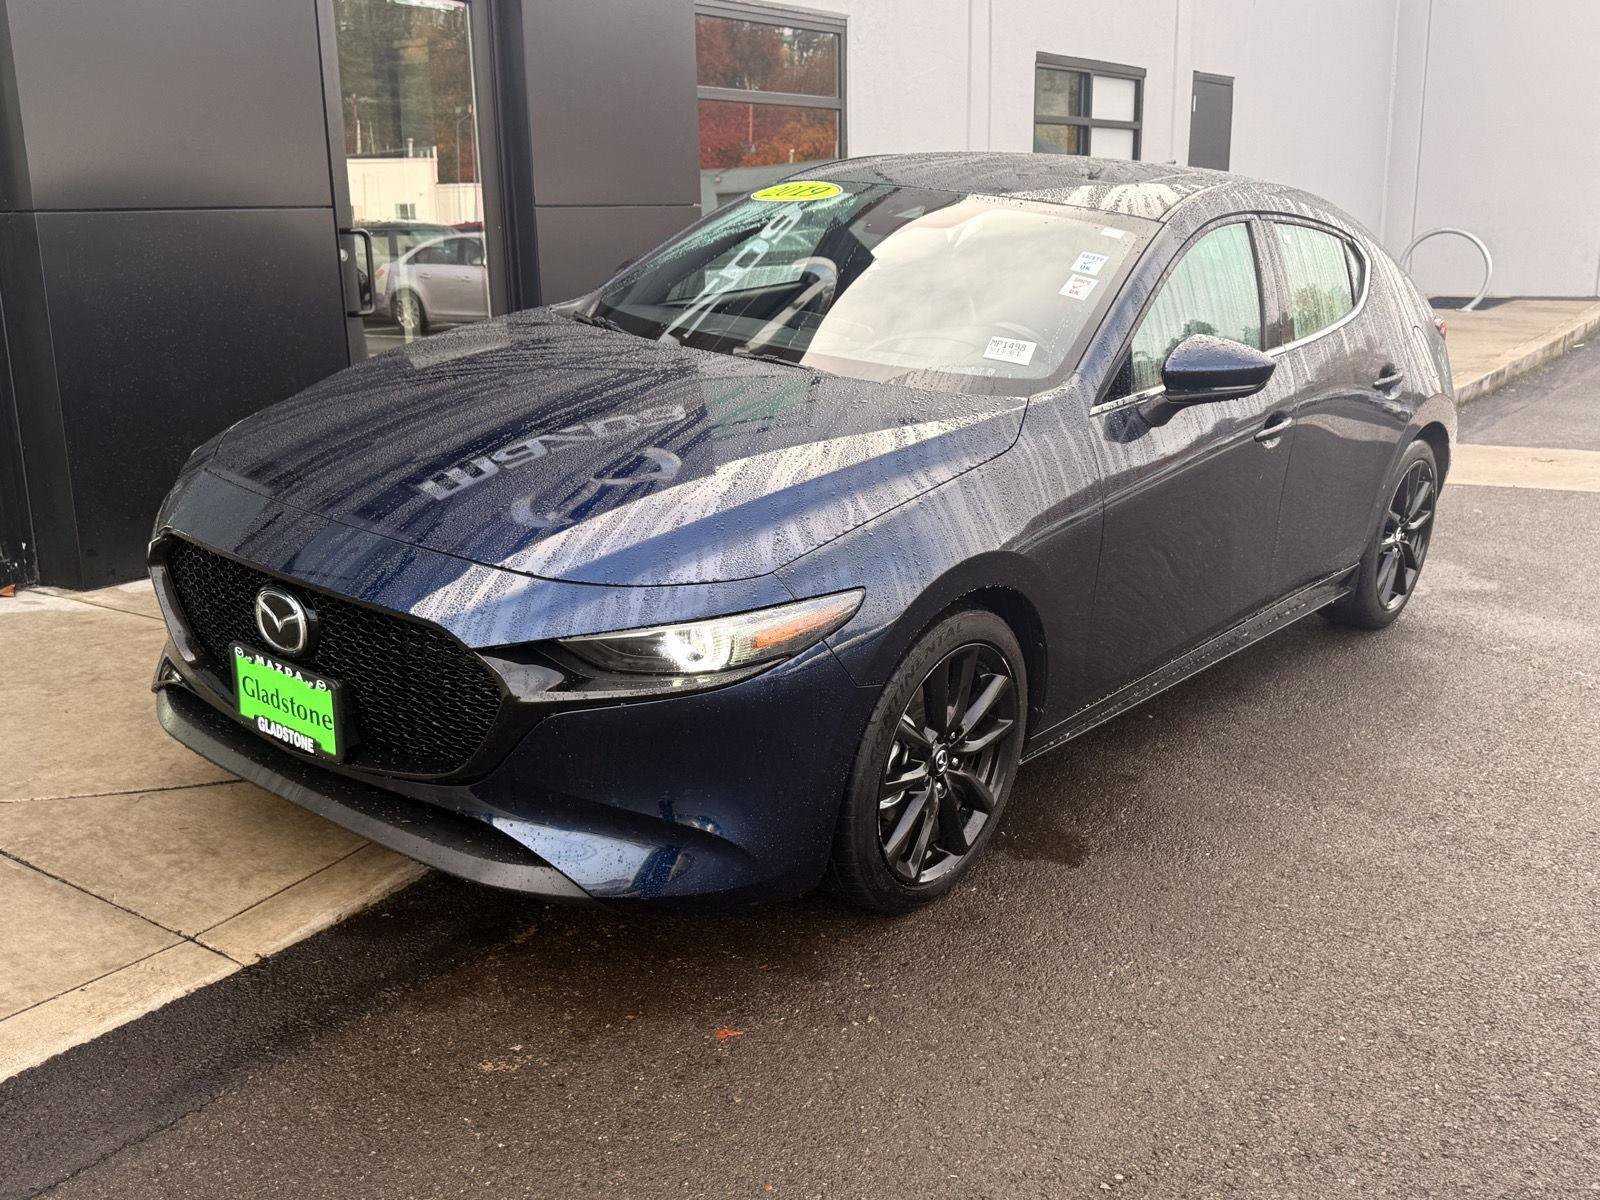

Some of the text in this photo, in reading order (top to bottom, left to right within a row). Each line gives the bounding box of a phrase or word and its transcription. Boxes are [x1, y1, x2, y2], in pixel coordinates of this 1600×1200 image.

[989, 338, 1027, 352] MP1498
[255, 653, 304, 681] MAZDA
[242, 675, 333, 731] Gladstone
[257, 716, 315, 754] GLADSTONE
